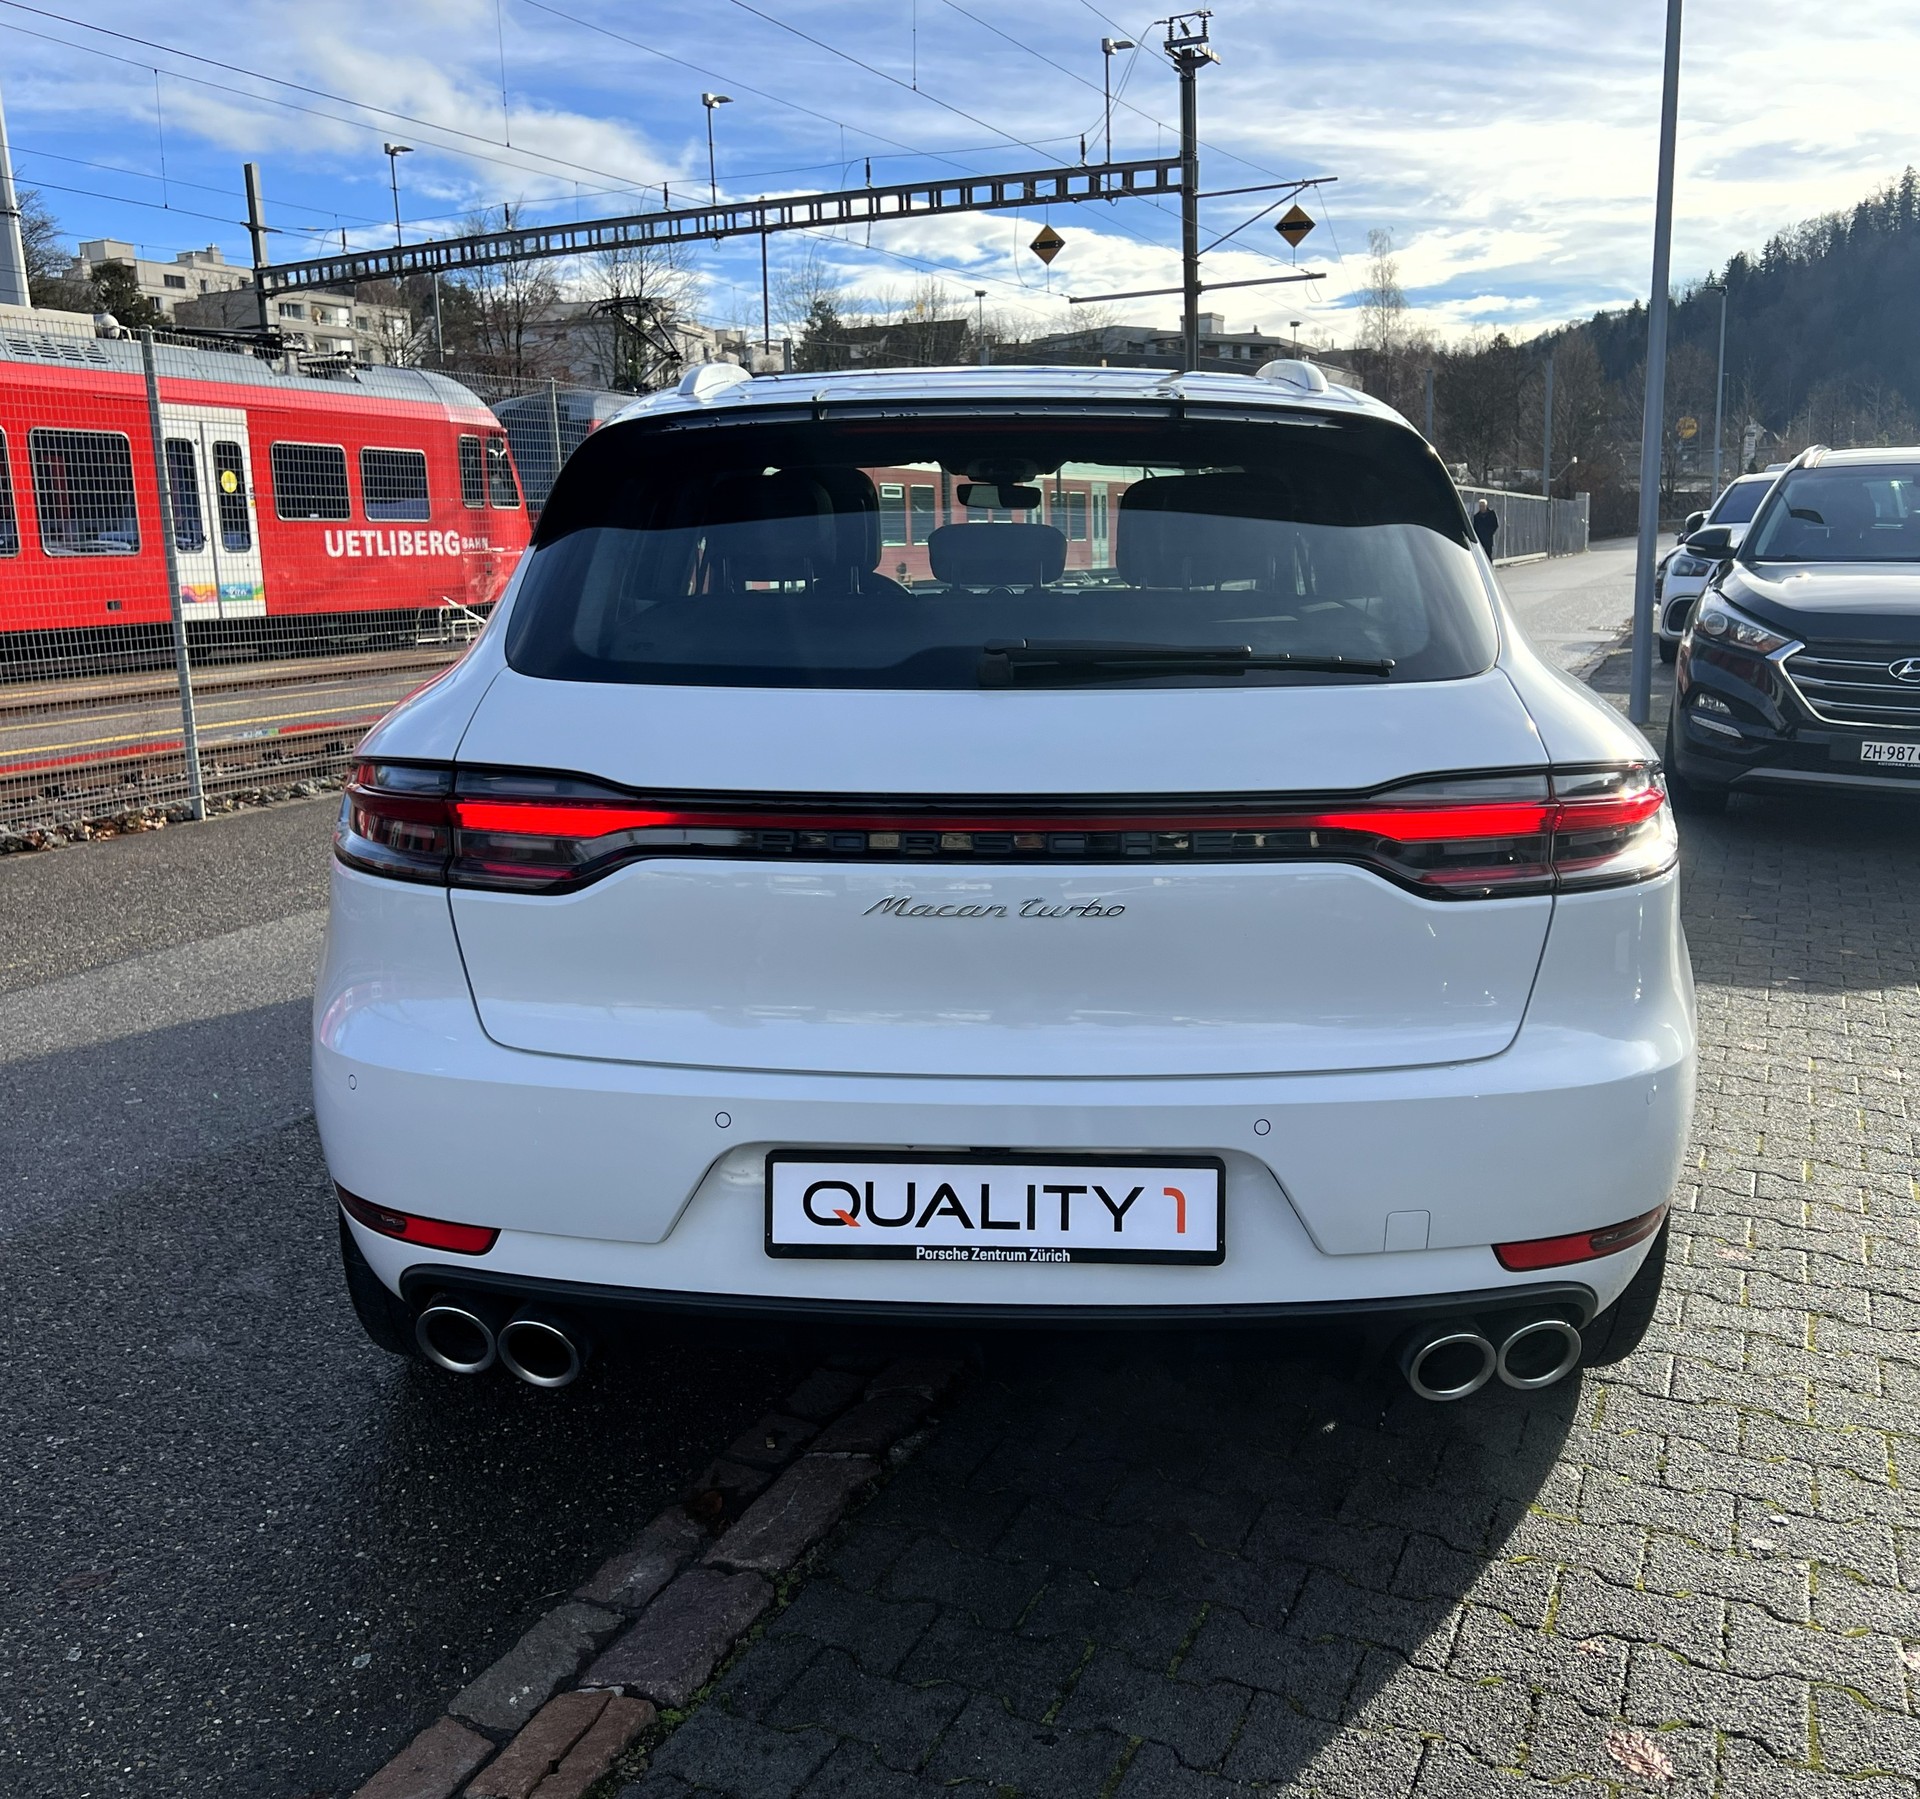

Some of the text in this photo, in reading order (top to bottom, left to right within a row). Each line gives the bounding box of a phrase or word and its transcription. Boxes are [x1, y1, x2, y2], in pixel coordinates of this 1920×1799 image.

[324, 529, 489, 557] UETLIBERG BAHN
[1863, 744, 1920, 761] ZH·987
[862, 894, 1126, 918] Macan turbo
[802, 1180, 1186, 1234] QUALITY 1
[916, 1246, 1071, 1263] Porsche Zentrum Zürich
